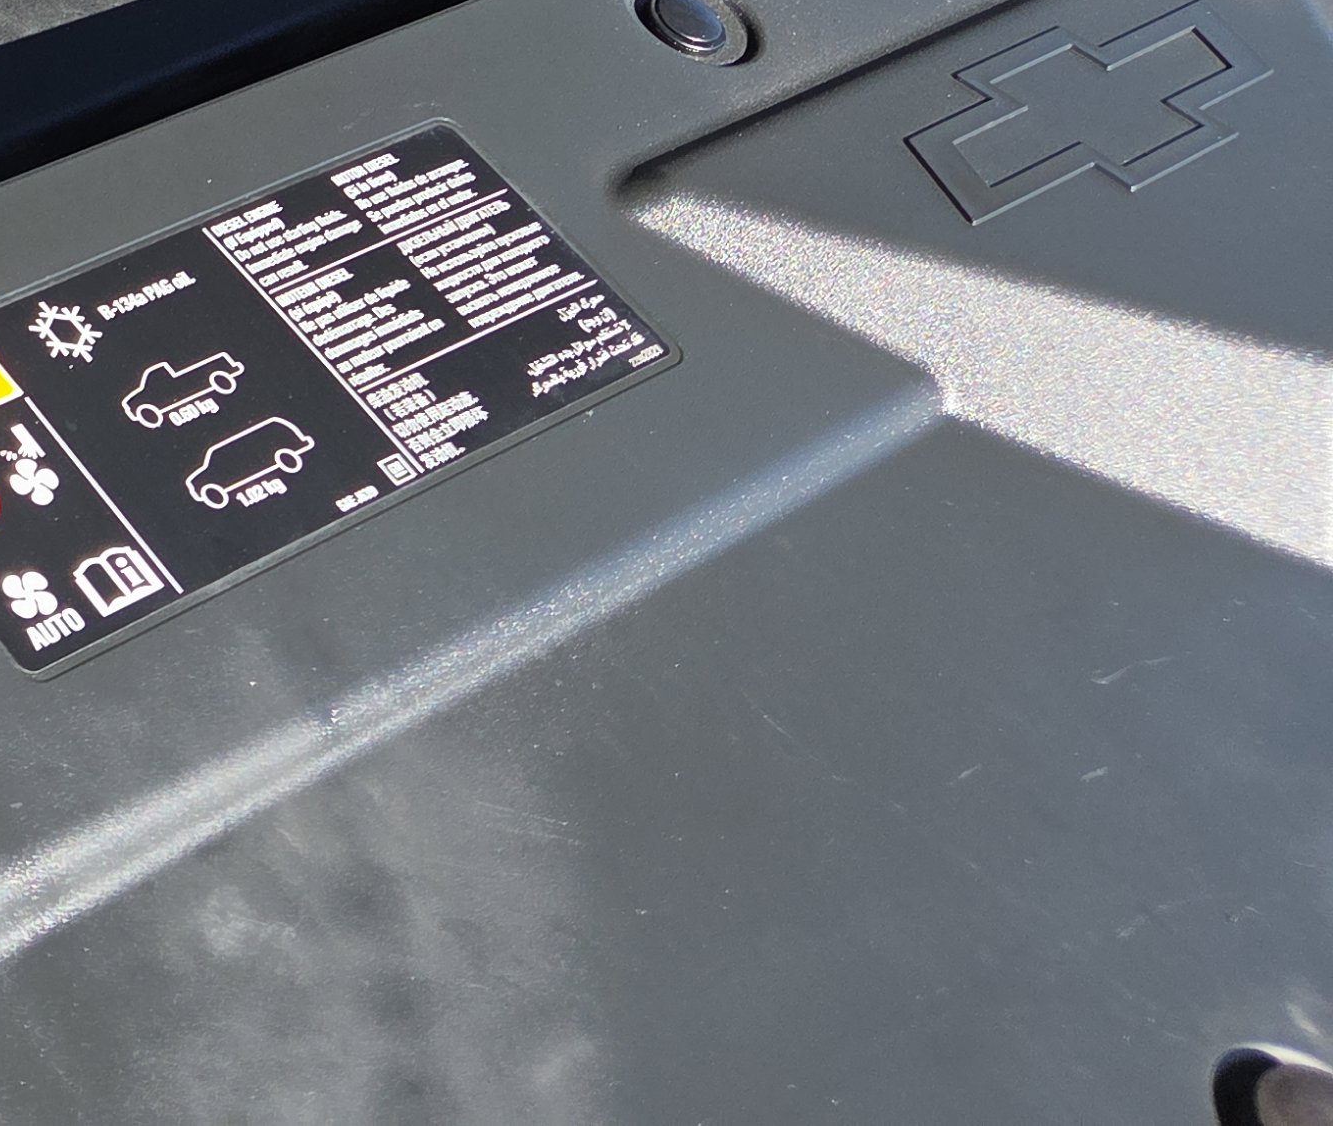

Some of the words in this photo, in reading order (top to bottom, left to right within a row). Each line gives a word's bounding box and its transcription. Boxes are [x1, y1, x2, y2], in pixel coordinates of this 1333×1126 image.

[330, 165, 369, 187] MOTOR
[362, 153, 400, 174] DIESEL
[210, 215, 249, 238] DIESEL
[242, 200, 284, 224] ENGINE
[365, 210, 384, 223] Se
[294, 234, 328, 255] engine
[323, 219, 363, 242] damage
[258, 272, 280, 288] can
[276, 259, 310, 280] result.
[274, 281, 321, 308] MOTEUR
[314, 267, 354, 290] DIESEL
[96, 292, 149, 321] R-134a
[141, 278, 176, 301] PAG
[168, 403, 201, 427] 0.60
[194, 397, 220, 415] kg
[235, 484, 269, 507] 1.02
[260, 478, 288, 495] kg
[26, 607, 86, 652] AUTO
